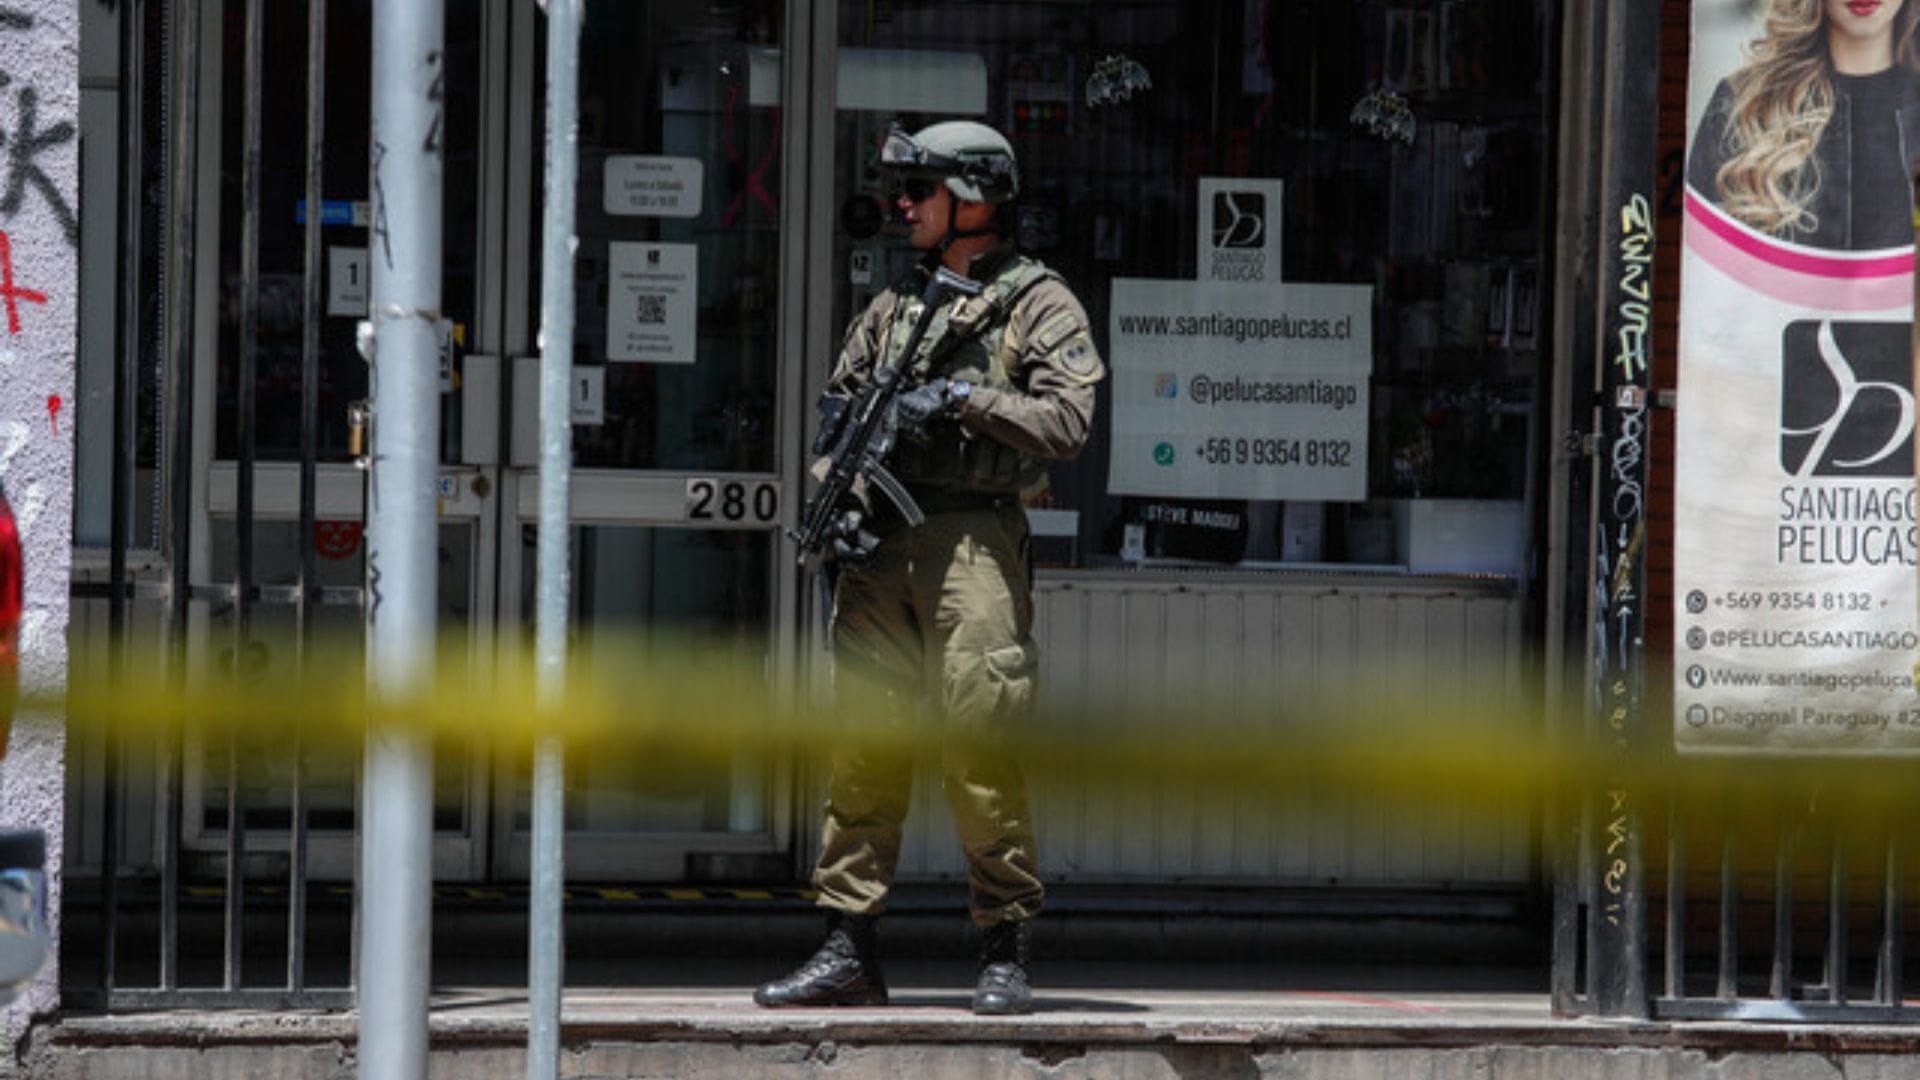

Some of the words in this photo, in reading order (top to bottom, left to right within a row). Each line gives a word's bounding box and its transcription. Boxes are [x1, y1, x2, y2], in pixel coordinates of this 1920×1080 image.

[347, 261, 358, 285] 1
[1212, 265, 1264, 281] PELUCAS
[1119, 313, 1351, 342] www.santiagopelucas.cl
[580, 379, 589, 401] 1
[1189, 375, 1357, 410] @pelucasantiago
[1196, 438, 1231, 465] +56
[1236, 439, 1248, 465] 9
[1253, 440, 1300, 466] 9354
[1306, 440, 1351, 467] 8132
[689, 481, 778, 521] 280
[1779, 486, 1917, 521] SANTIAGO
[1777, 525, 1917, 565] PELUCAS
[1713, 592, 1762, 611] +569
[1769, 592, 1816, 611] 9354
[1822, 592, 1872, 611] 8132
[1710, 630, 1918, 651] @PELUCASANTIAGO
[1710, 668, 1912, 691] Www.santiagopeluca
[1712, 706, 1796, 729] Diagonal
[1802, 706, 1890, 730] Paraguay
